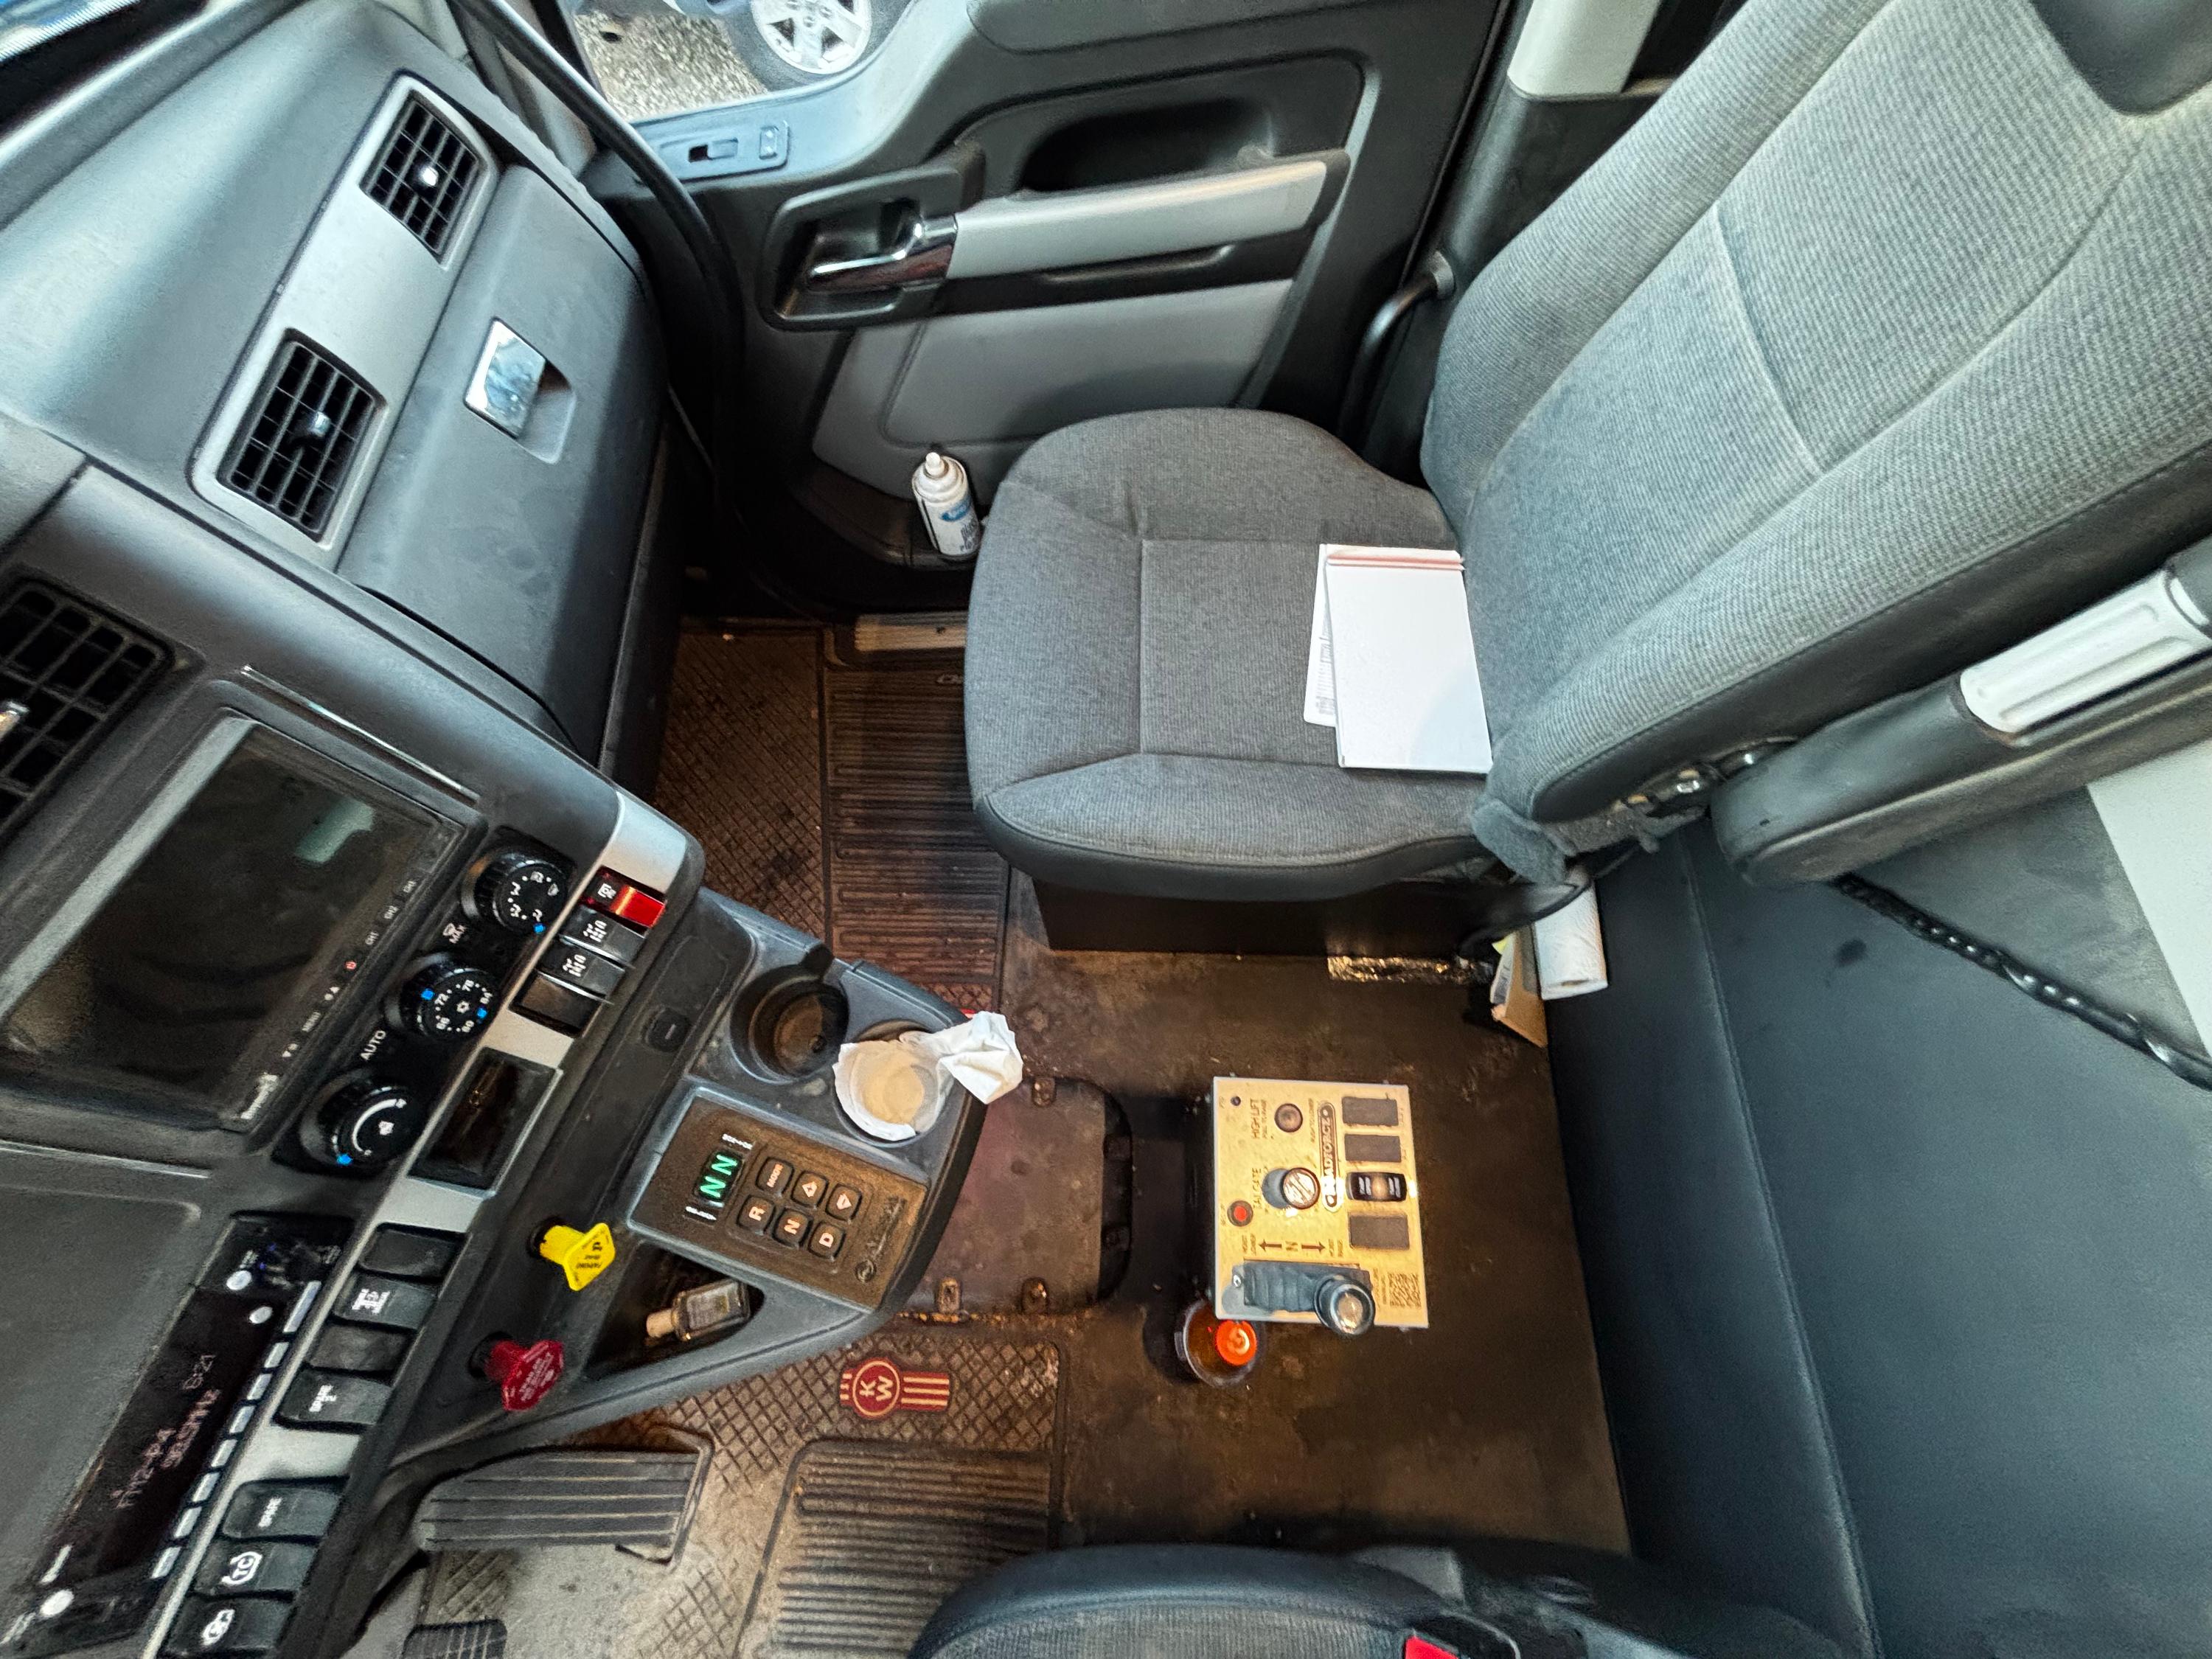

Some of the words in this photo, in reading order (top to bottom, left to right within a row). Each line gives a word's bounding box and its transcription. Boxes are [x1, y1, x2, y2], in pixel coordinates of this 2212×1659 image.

[449, 925, 467, 944] MAX
[434, 993, 451, 1006] 72
[360, 1030, 386, 1061] AUTO
[766, 1163, 785, 1189] MODE
[748, 1206, 766, 1222] R
[784, 1219, 801, 1235] N
[818, 1232, 834, 1248] D
[859, 1375, 894, 1402] KW
[232, 1557, 254, 1581] TC
